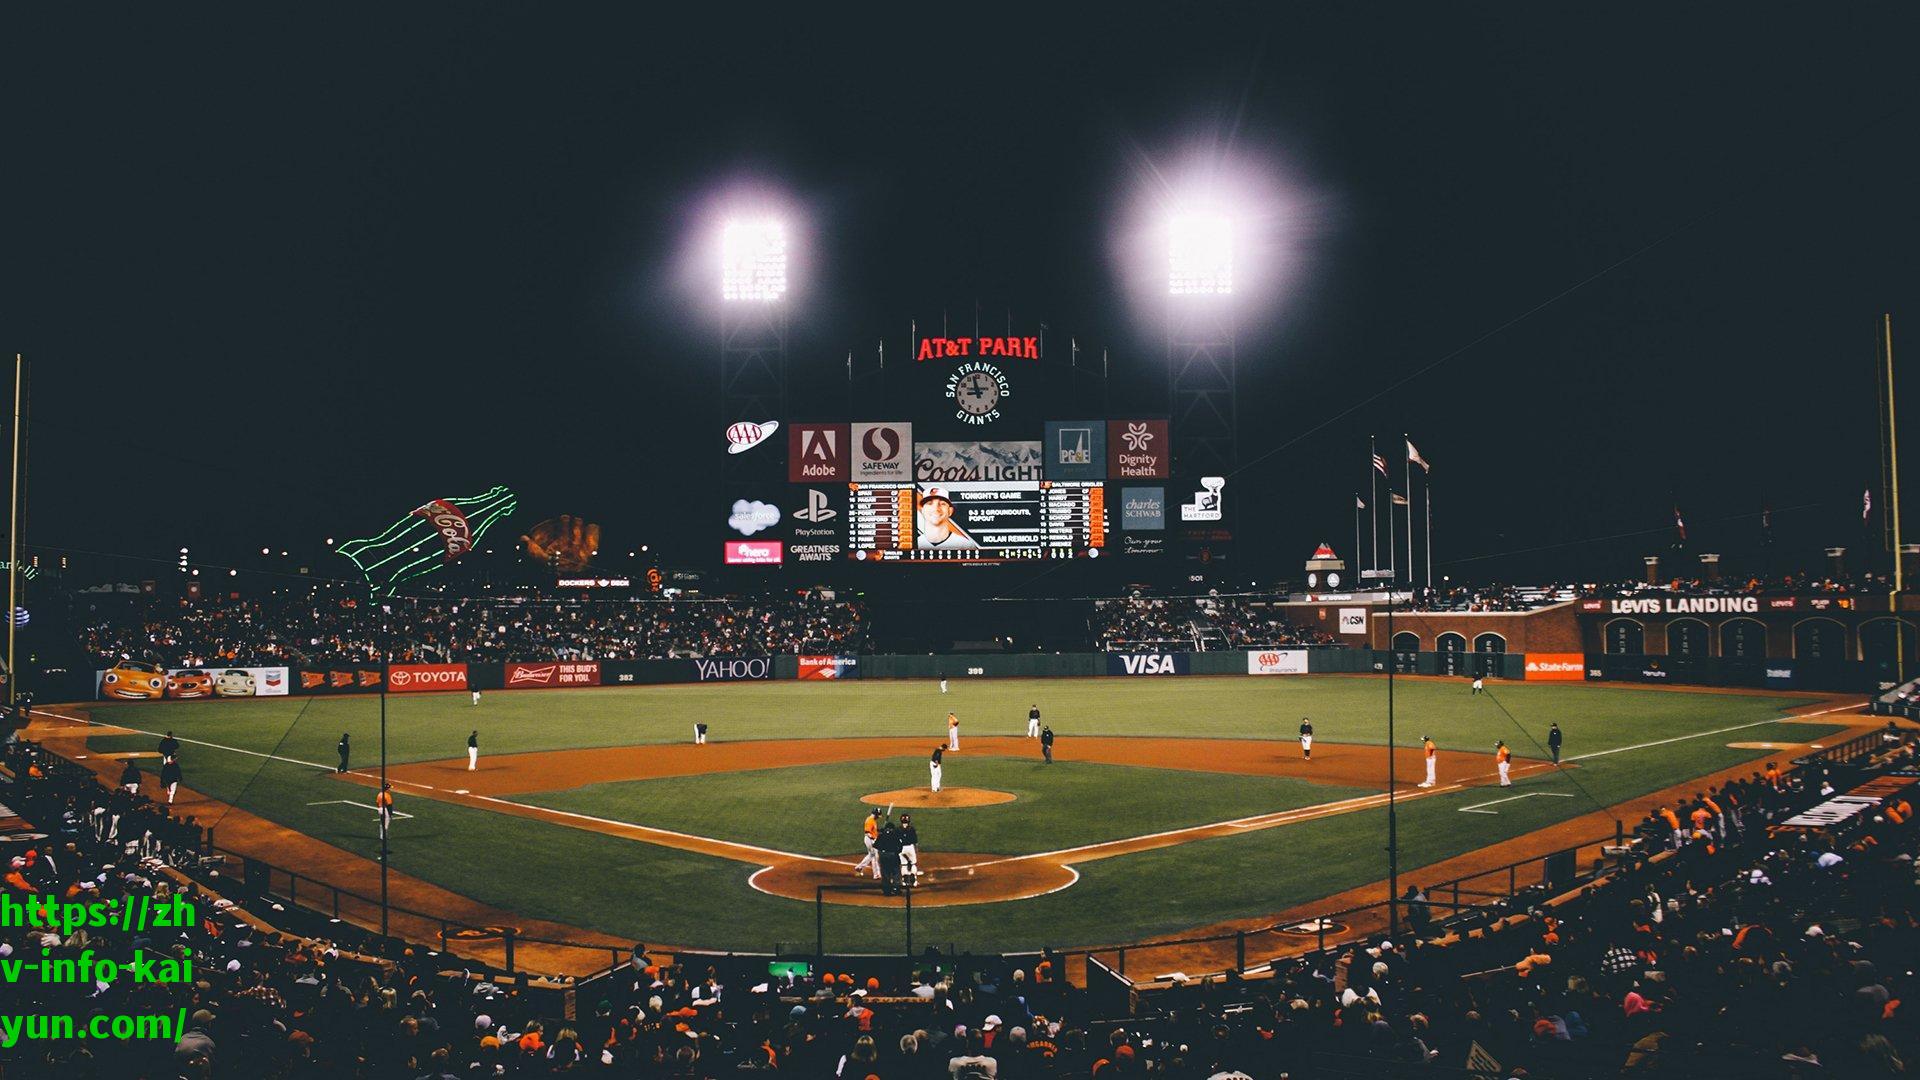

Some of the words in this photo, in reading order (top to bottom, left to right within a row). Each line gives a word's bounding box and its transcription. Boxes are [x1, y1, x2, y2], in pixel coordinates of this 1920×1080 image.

[917, 337, 973, 361] AT&T
[979, 336, 1038, 360] PARK
[945, 373, 960, 398] SAN
[957, 361, 1010, 397] FRANCISCO
[956, 408, 1001, 425] GIANTS
[1061, 449, 1089, 463] PG&E
[1119, 454, 1157, 467] Dignity
[802, 464, 836, 476] Adobe
[862, 462, 900, 470] SAFEWAY
[916, 458, 981, 481] Coors
[984, 465, 1043, 481] LIGHT
[1121, 466, 1156, 476] Health
[960, 492, 998, 500] TONIGHT'S
[1126, 498, 1161, 510] charles
[733, 510, 775, 521] salesforce
[1125, 509, 1161, 518] SCHWAB
[434, 514, 470, 555] Cola
[795, 528, 835, 538] PlayStation
[1124, 535, 1143, 545] Own
[1143, 538, 1162, 548] your
[790, 544, 840, 554] GREATNESS
[799, 553, 832, 562] AWAITS
[1666, 597, 1758, 613] LANDING
[1350, 616, 1364, 625] CSN
[830, 658, 856, 666] America
[1119, 654, 1176, 675] VISA
[1540, 662, 1562, 672] State
[1562, 662, 1584, 672] Farm
[515, 667, 551, 680] Budweiser
[559, 665, 575, 674] THIS
[576, 664, 598, 674] BUD'S
[696, 658, 771, 680] YAHOO!
[413, 672, 466, 682] TOYOTA
[559, 674, 573, 682] FOR
[574, 673, 590, 682] YOU.
